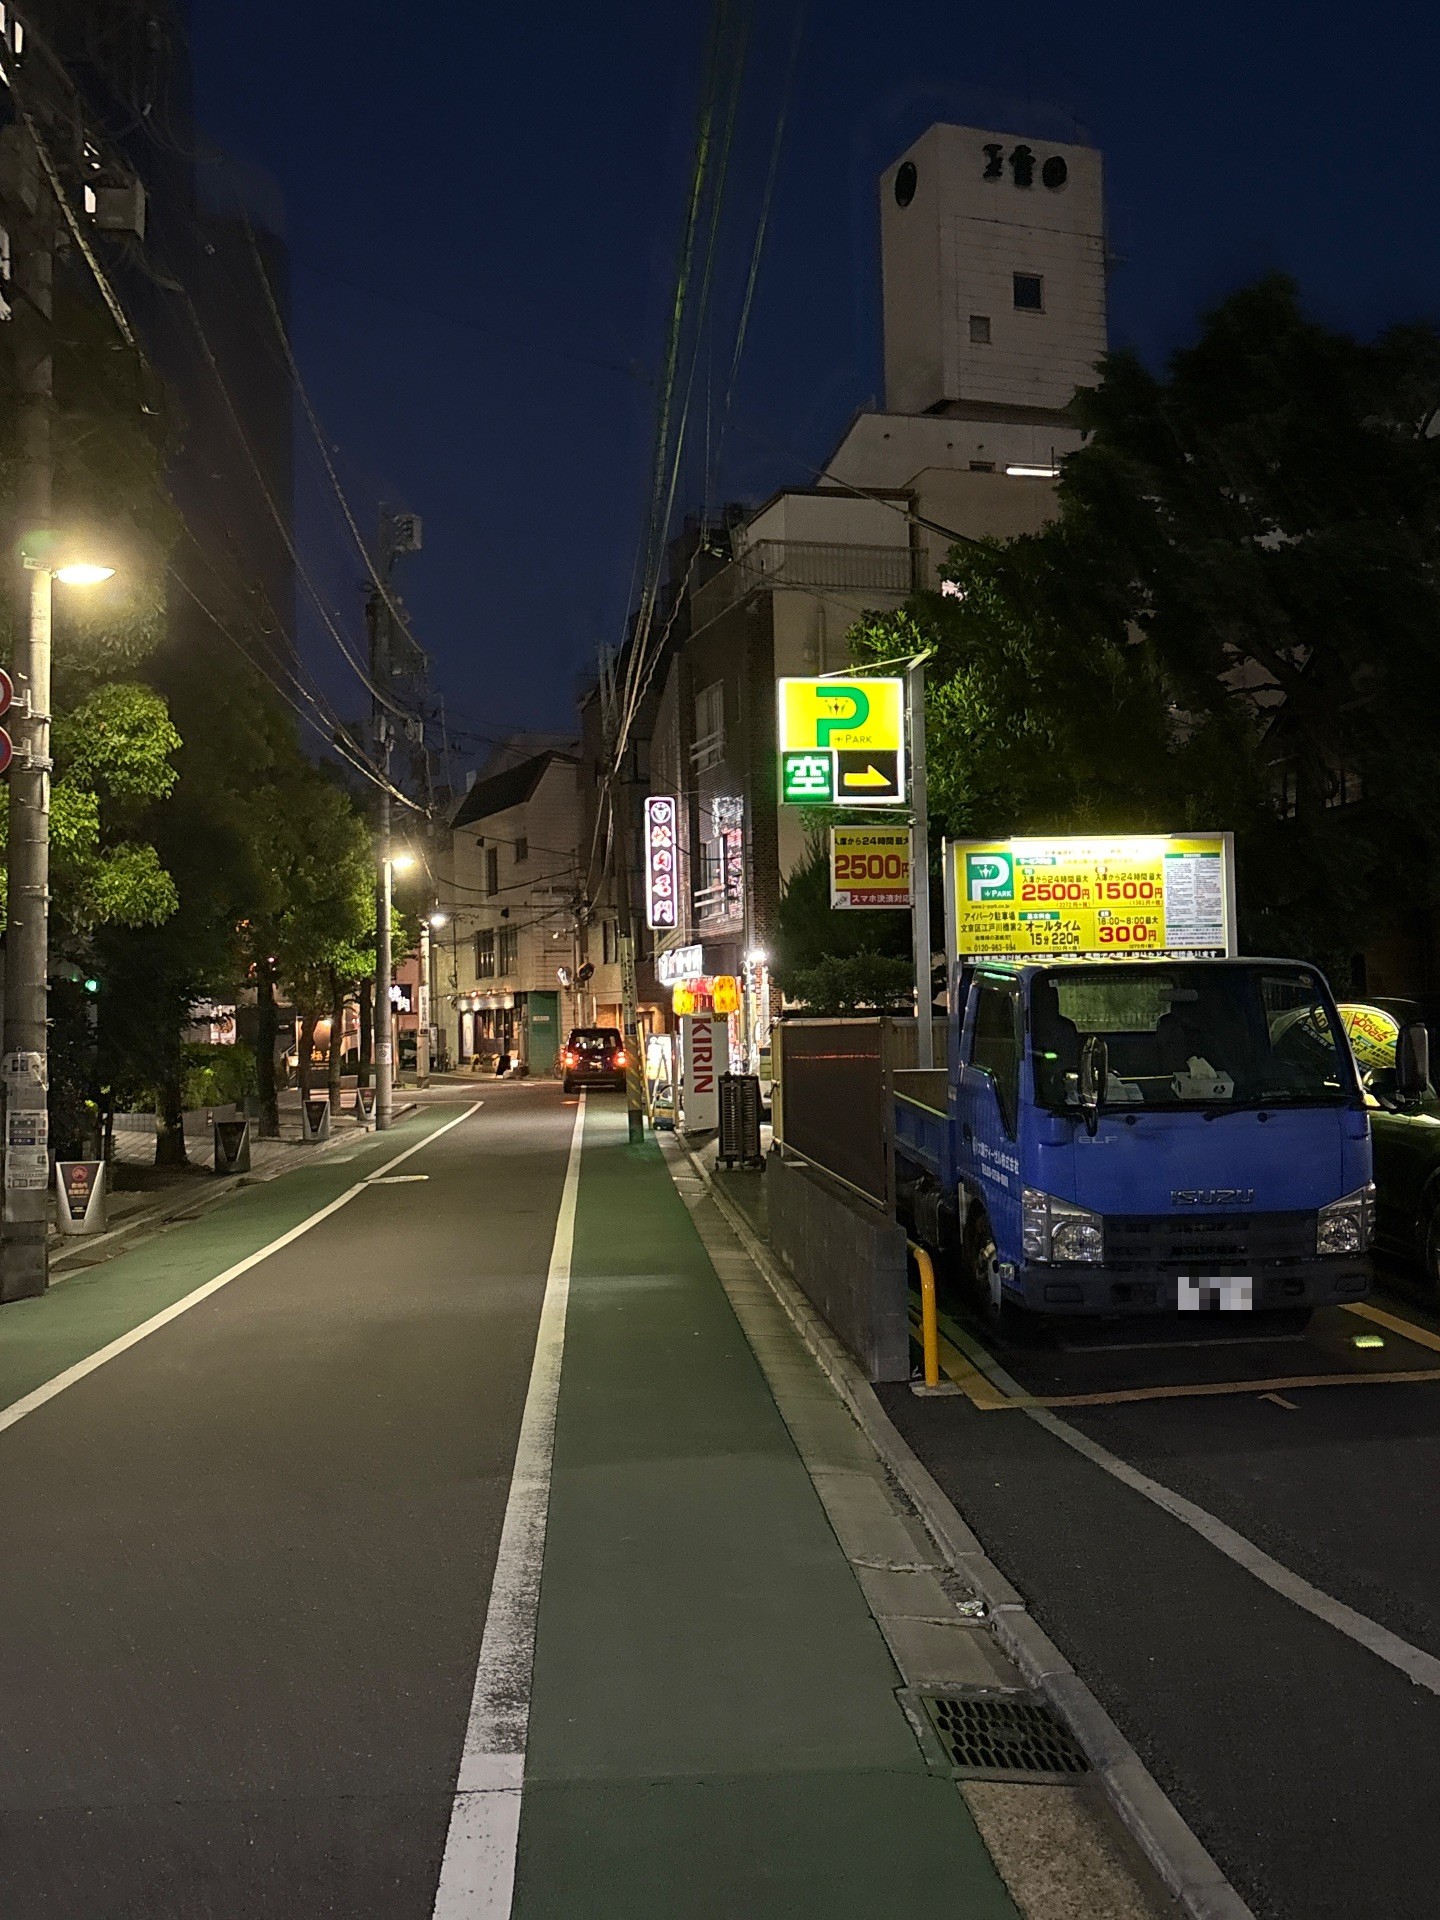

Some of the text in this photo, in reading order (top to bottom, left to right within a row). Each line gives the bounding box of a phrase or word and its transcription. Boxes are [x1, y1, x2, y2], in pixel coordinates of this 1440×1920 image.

[816, 687, 870, 747] P
[845, 735, 872, 744] PARK
[787, 755, 830, 795] 空
[1022, 875, 1089, 884] 入庫から24時間最大
[1095, 872, 1163, 882] 入庫から24時間最大
[991, 890, 1012, 898] PARK
[1022, 883, 1090, 901] 2500円
[1095, 882, 1163, 900] 1500円
[964, 911, 1016, 922] アイパーク駐車場
[960, 922, 1022, 933] 文京区江戸川橋第2
[1025, 920, 1081, 932] オールタイム
[1098, 924, 1157, 943] 300円
[691, 1017, 714, 1093] KIRIN
[1077, 1136, 1119, 1144] ELF
[1170, 1188, 1254, 1205] ISUZU
